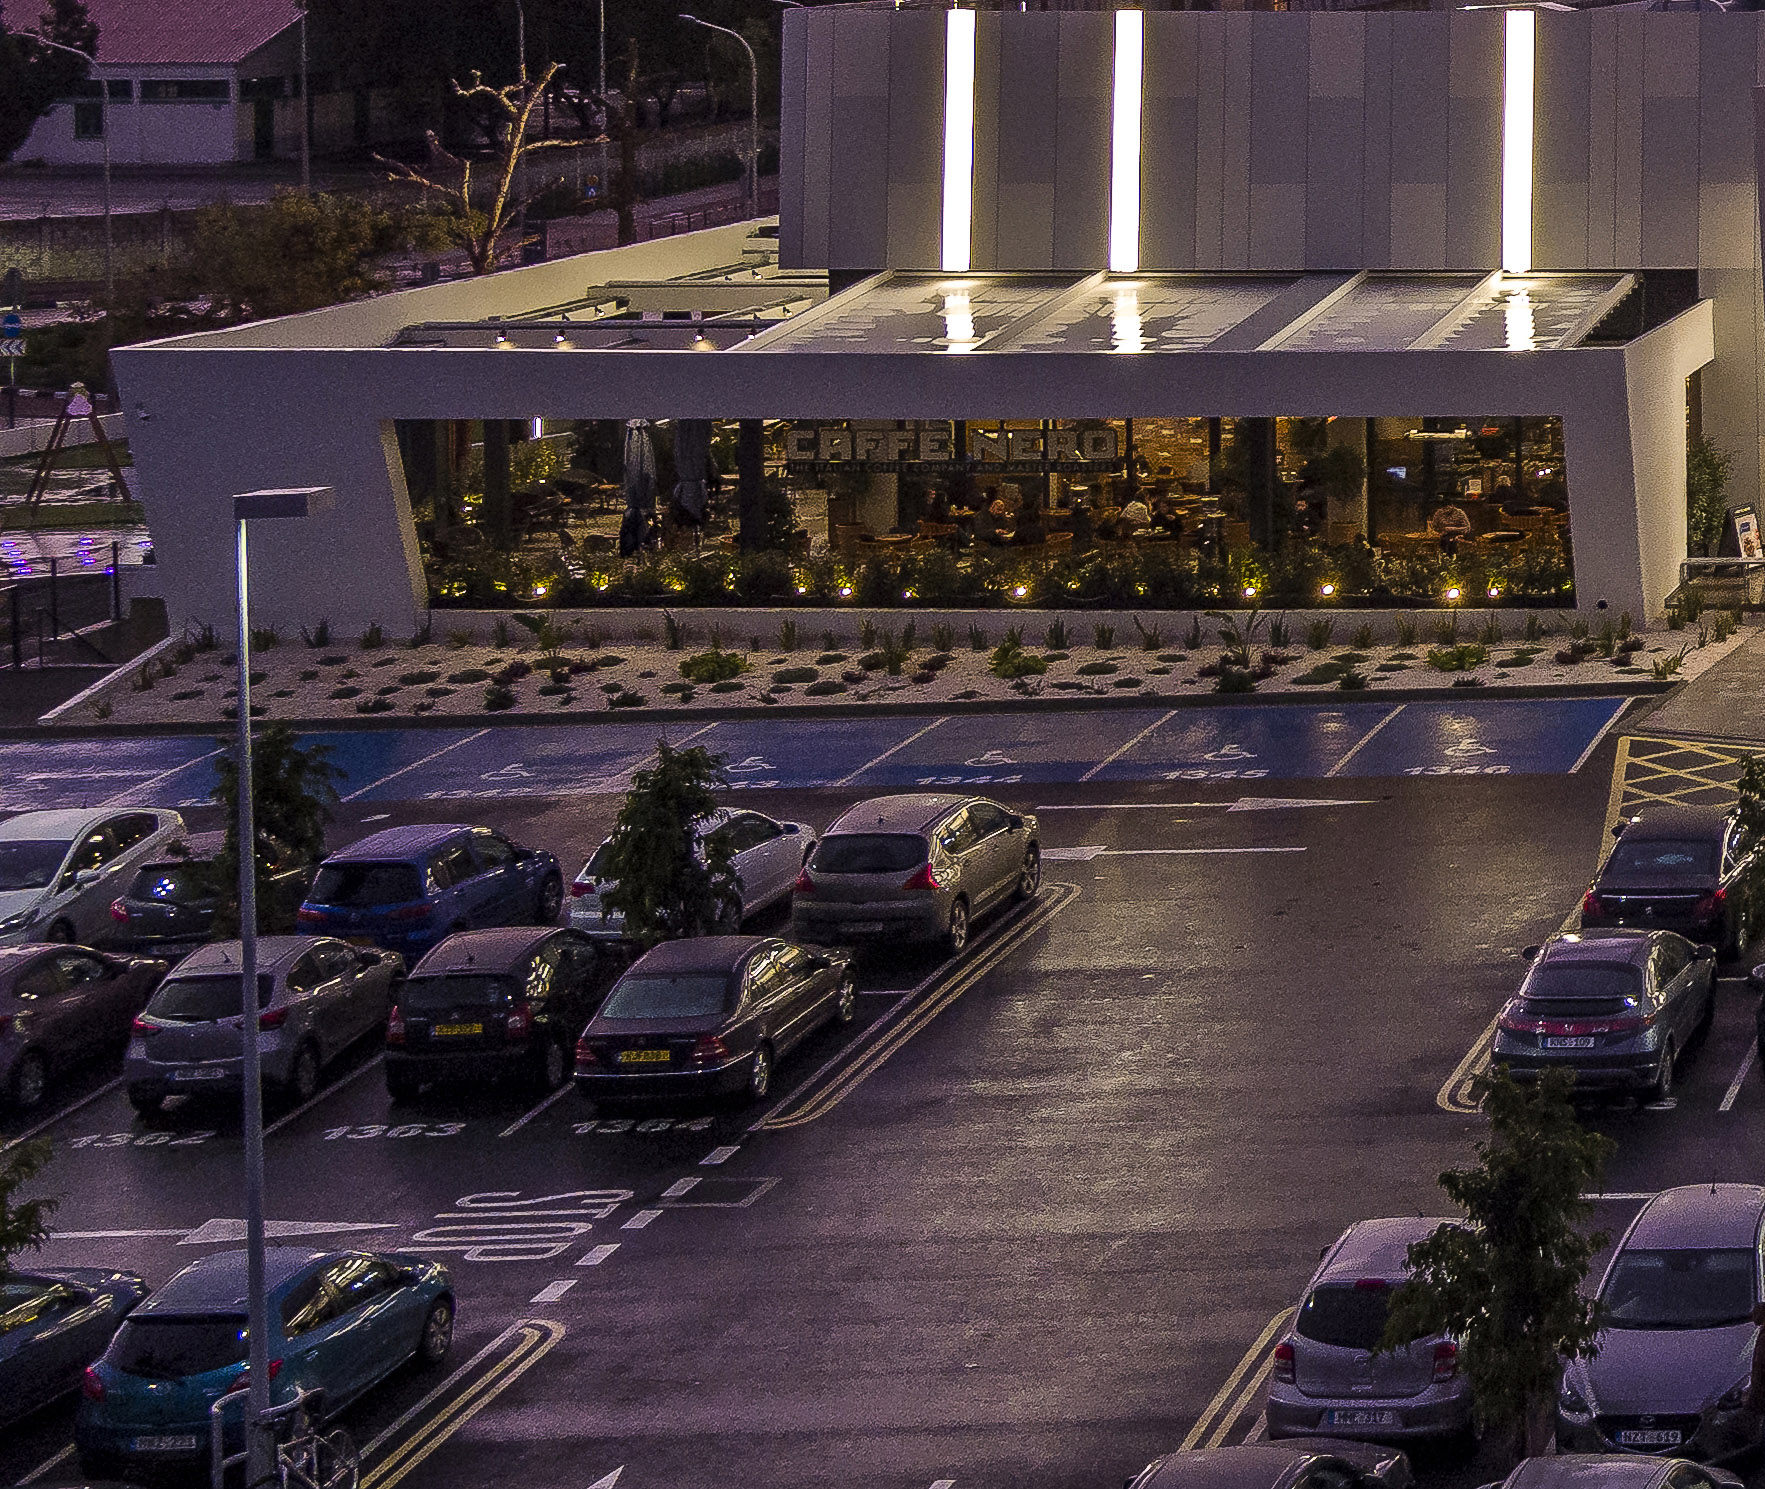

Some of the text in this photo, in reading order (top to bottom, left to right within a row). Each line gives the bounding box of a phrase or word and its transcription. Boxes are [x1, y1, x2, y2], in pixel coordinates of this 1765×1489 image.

[972, 429, 1117, 462] NERO
[866, 464, 908, 473] COFFEE
[912, 463, 971, 473] COMPANY
[1007, 463, 1050, 472] MASTER
[71, 1130, 216, 1149] 1302
[322, 1123, 468, 1141] 1303
[396, 1189, 635, 1262] STOP
